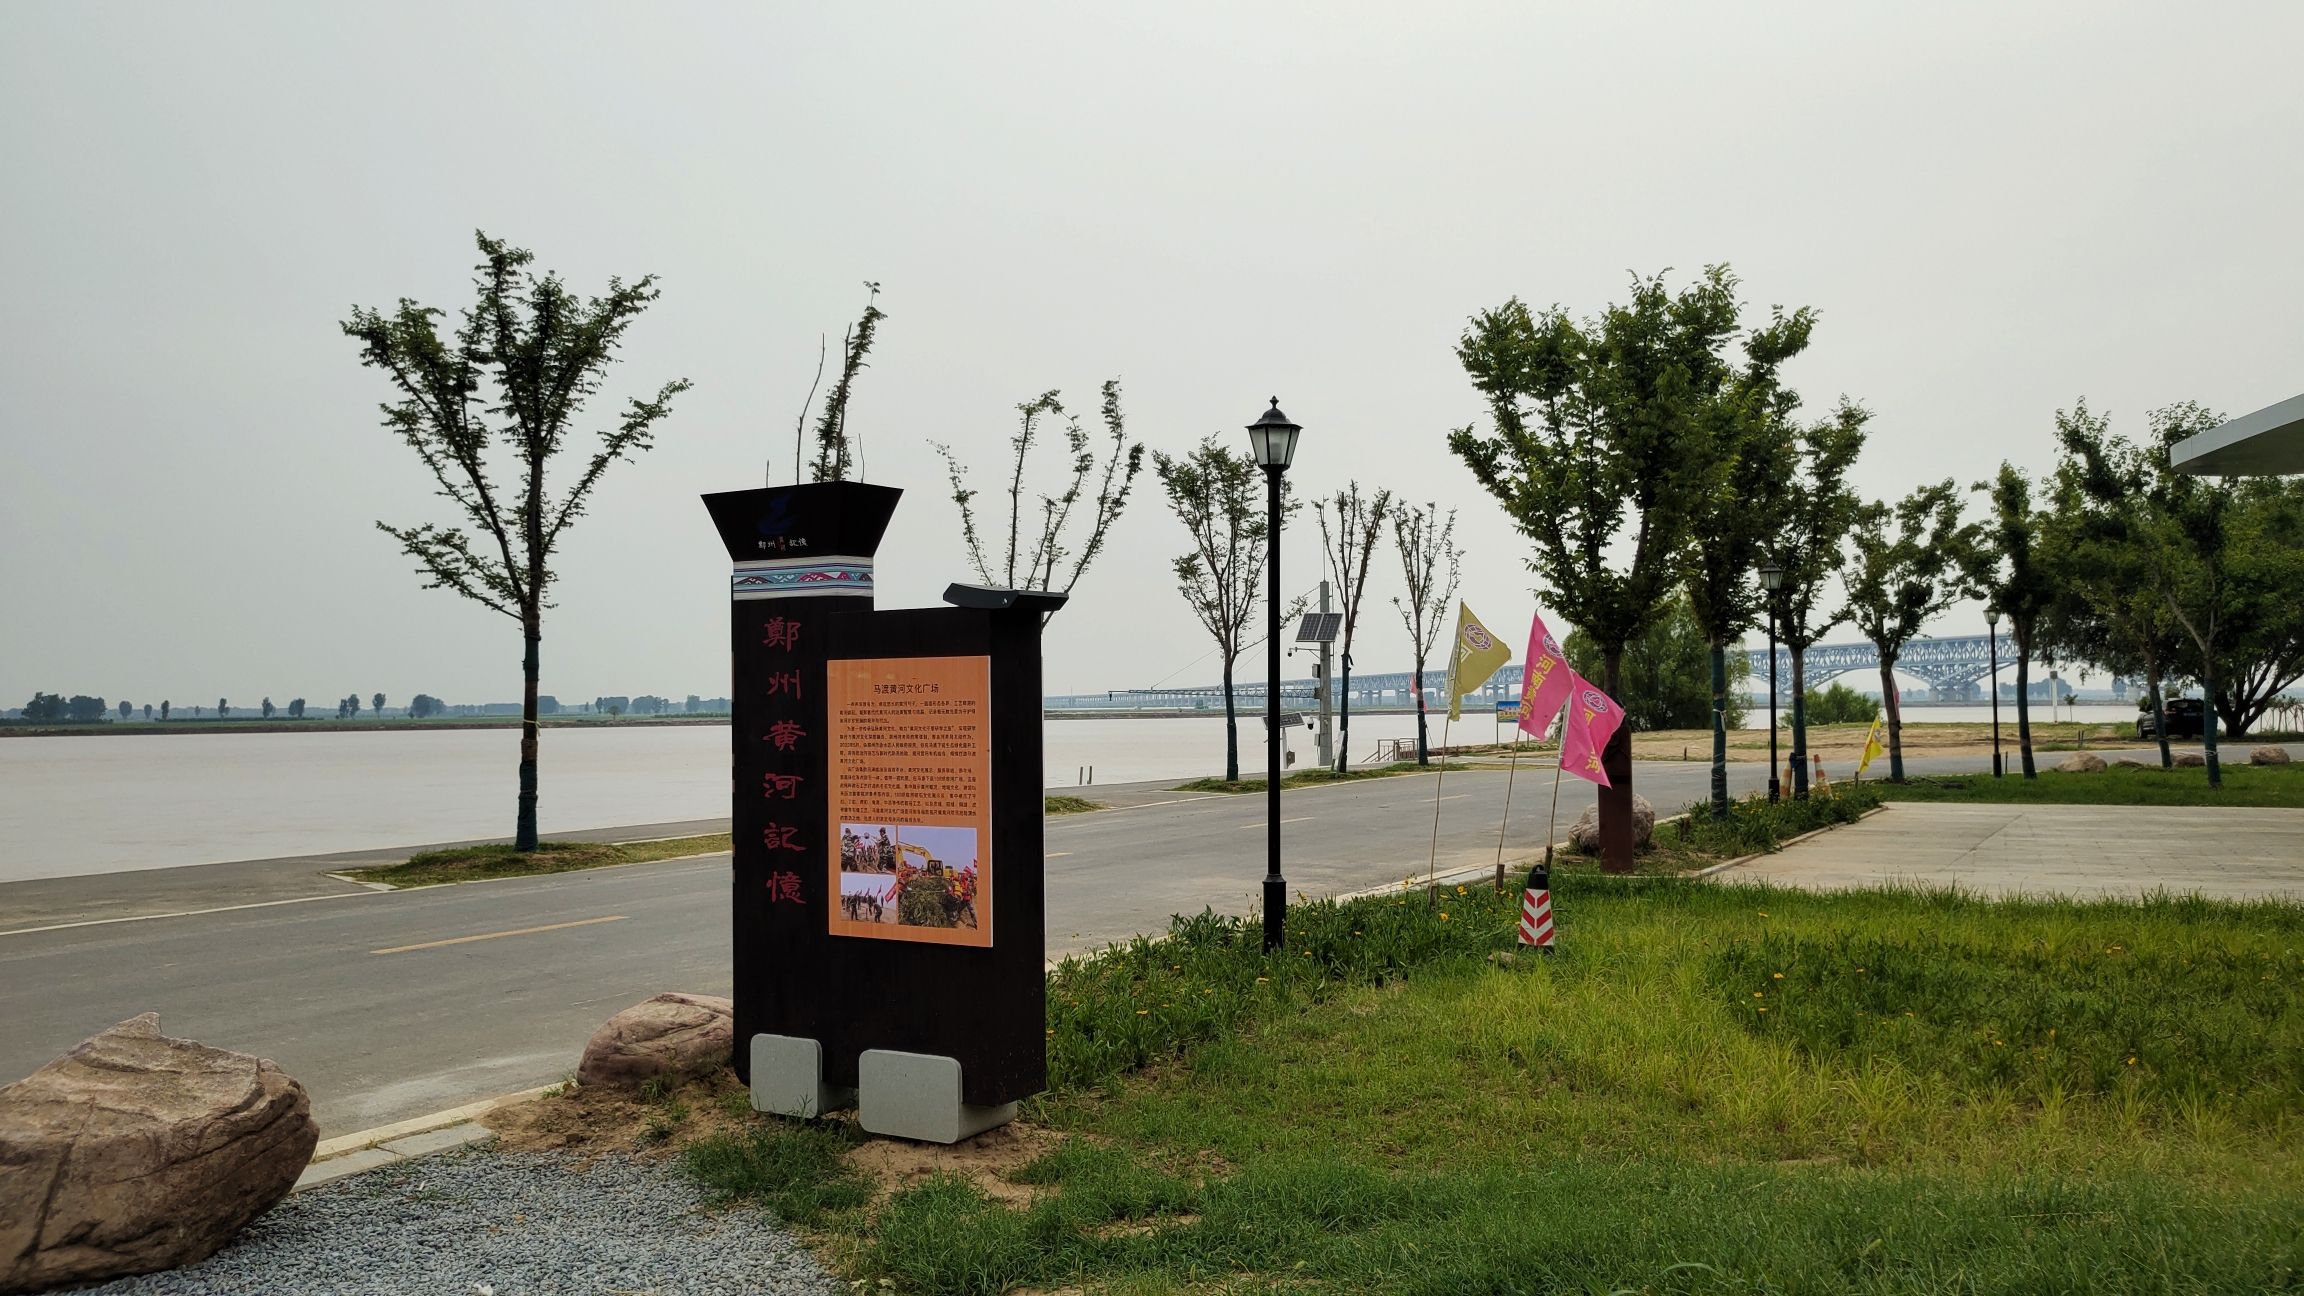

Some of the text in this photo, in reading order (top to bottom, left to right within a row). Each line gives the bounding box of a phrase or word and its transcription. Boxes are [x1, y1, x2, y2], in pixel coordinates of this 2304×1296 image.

[873, 683, 940, 695] 马渡黄河文化广场
